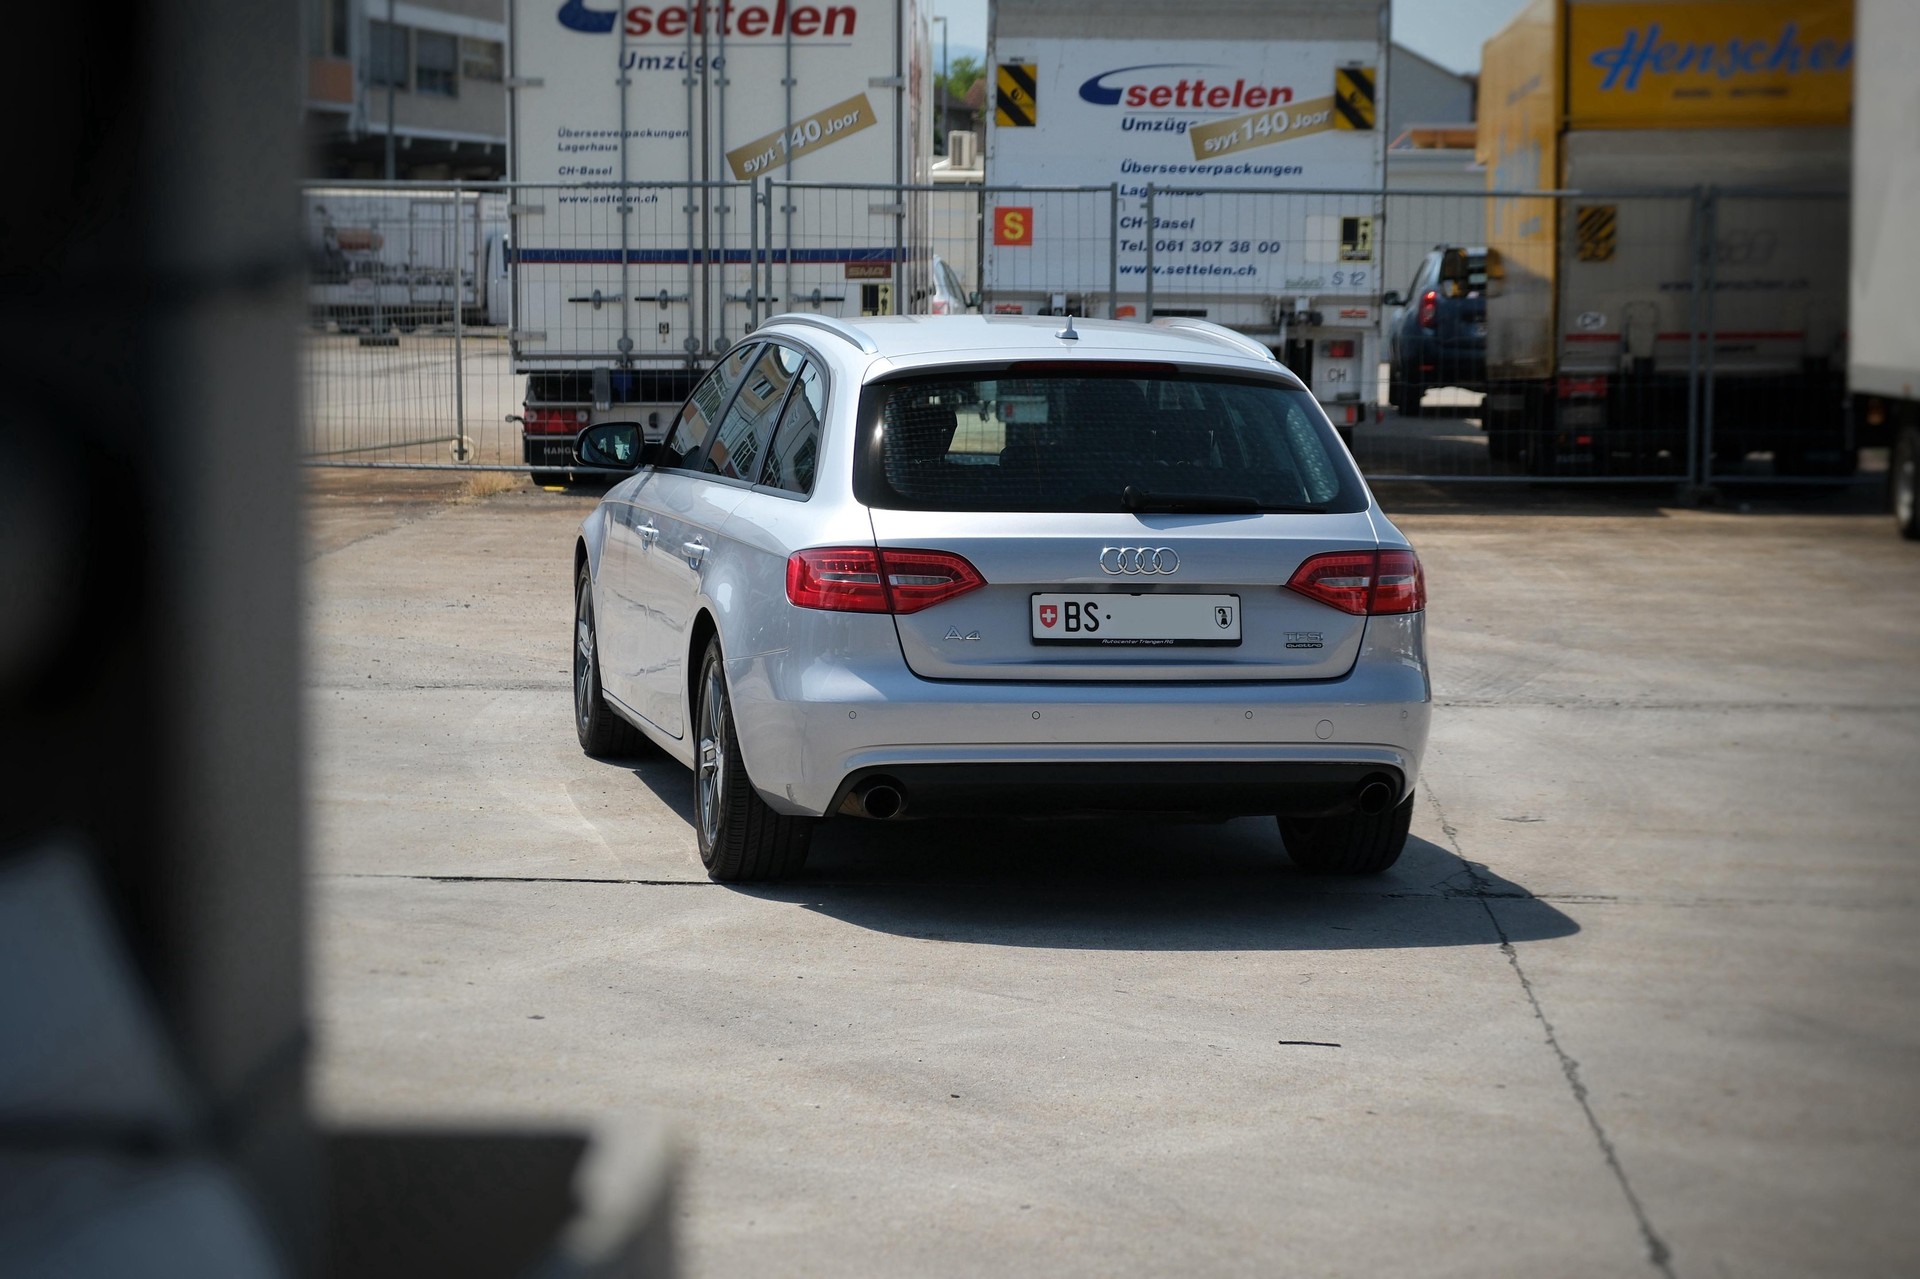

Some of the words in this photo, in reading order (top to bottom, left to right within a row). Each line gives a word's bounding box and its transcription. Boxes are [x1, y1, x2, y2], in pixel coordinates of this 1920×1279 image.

[625, 0, 857, 37] settelen
[1125, 79, 1294, 109] settelen
[1121, 117, 1197, 136] Umzüg
[1203, 129, 1240, 152] syyt
[1242, 111, 1290, 141] 140
[1292, 110, 1330, 130] Joor
[557, 142, 619, 153] Lagerhaus
[743, 147, 777, 173] syyt
[777, 119, 823, 156] 140
[825, 109, 861, 136] Joor
[558, 165, 613, 176] CH-Basel
[1121, 159, 1303, 178] Überseeverpackungen
[558, 194, 659, 204] www.setteen.ch
[1003, 211, 1025, 240] S
[1120, 216, 1195, 230] CH-Basel
[1120, 240, 1148, 252] Tel.
[1155, 240, 1184, 252] 061
[1191, 241, 1223, 253] 307
[1229, 241, 1250, 253] 38
[1257, 241, 1280, 254] 00
[1119, 264, 1257, 276] www.settelen.ch
[1328, 367, 1347, 383] CH
[943, 625, 982, 641] A4
[1284, 631, 1324, 641] TFSI
